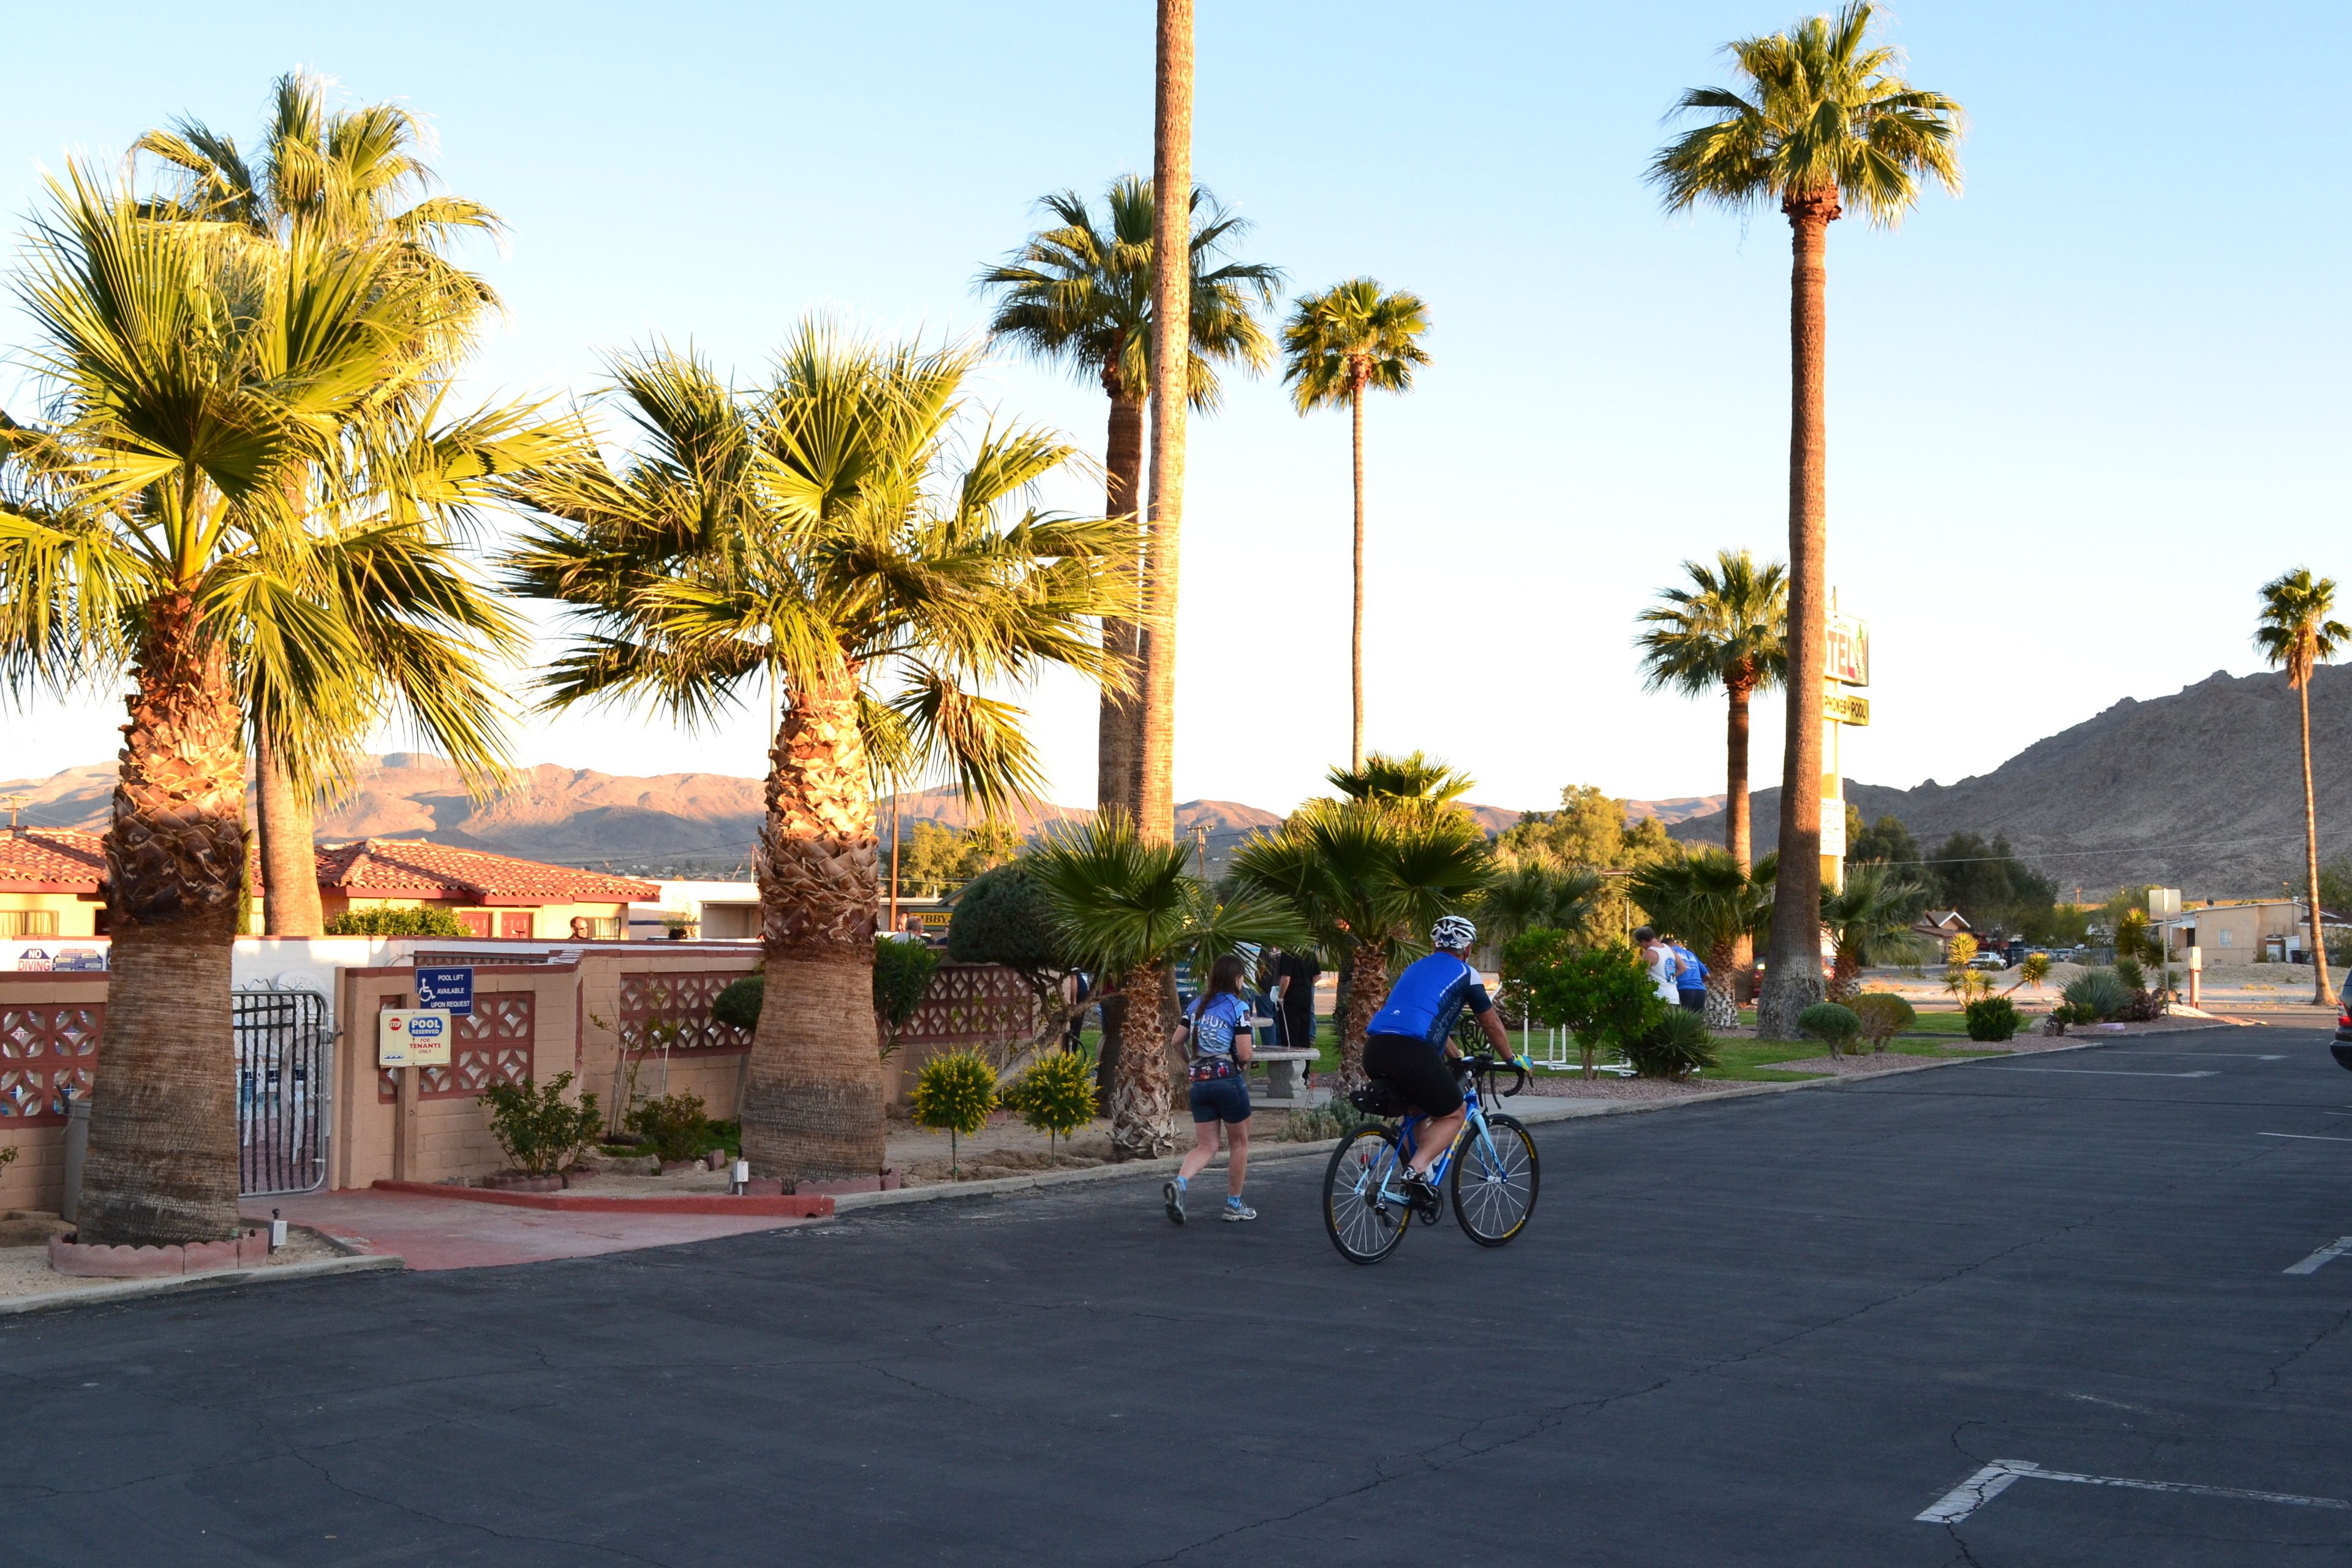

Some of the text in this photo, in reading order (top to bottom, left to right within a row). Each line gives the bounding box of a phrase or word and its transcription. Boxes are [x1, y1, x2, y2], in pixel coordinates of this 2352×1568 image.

[1823, 630, 1855, 678] TEL
[1851, 702, 1866, 719] POOL
[28, 949, 42, 959] NO
[18, 960, 50, 971] DIVING
[412, 1020, 440, 1028] POOL
